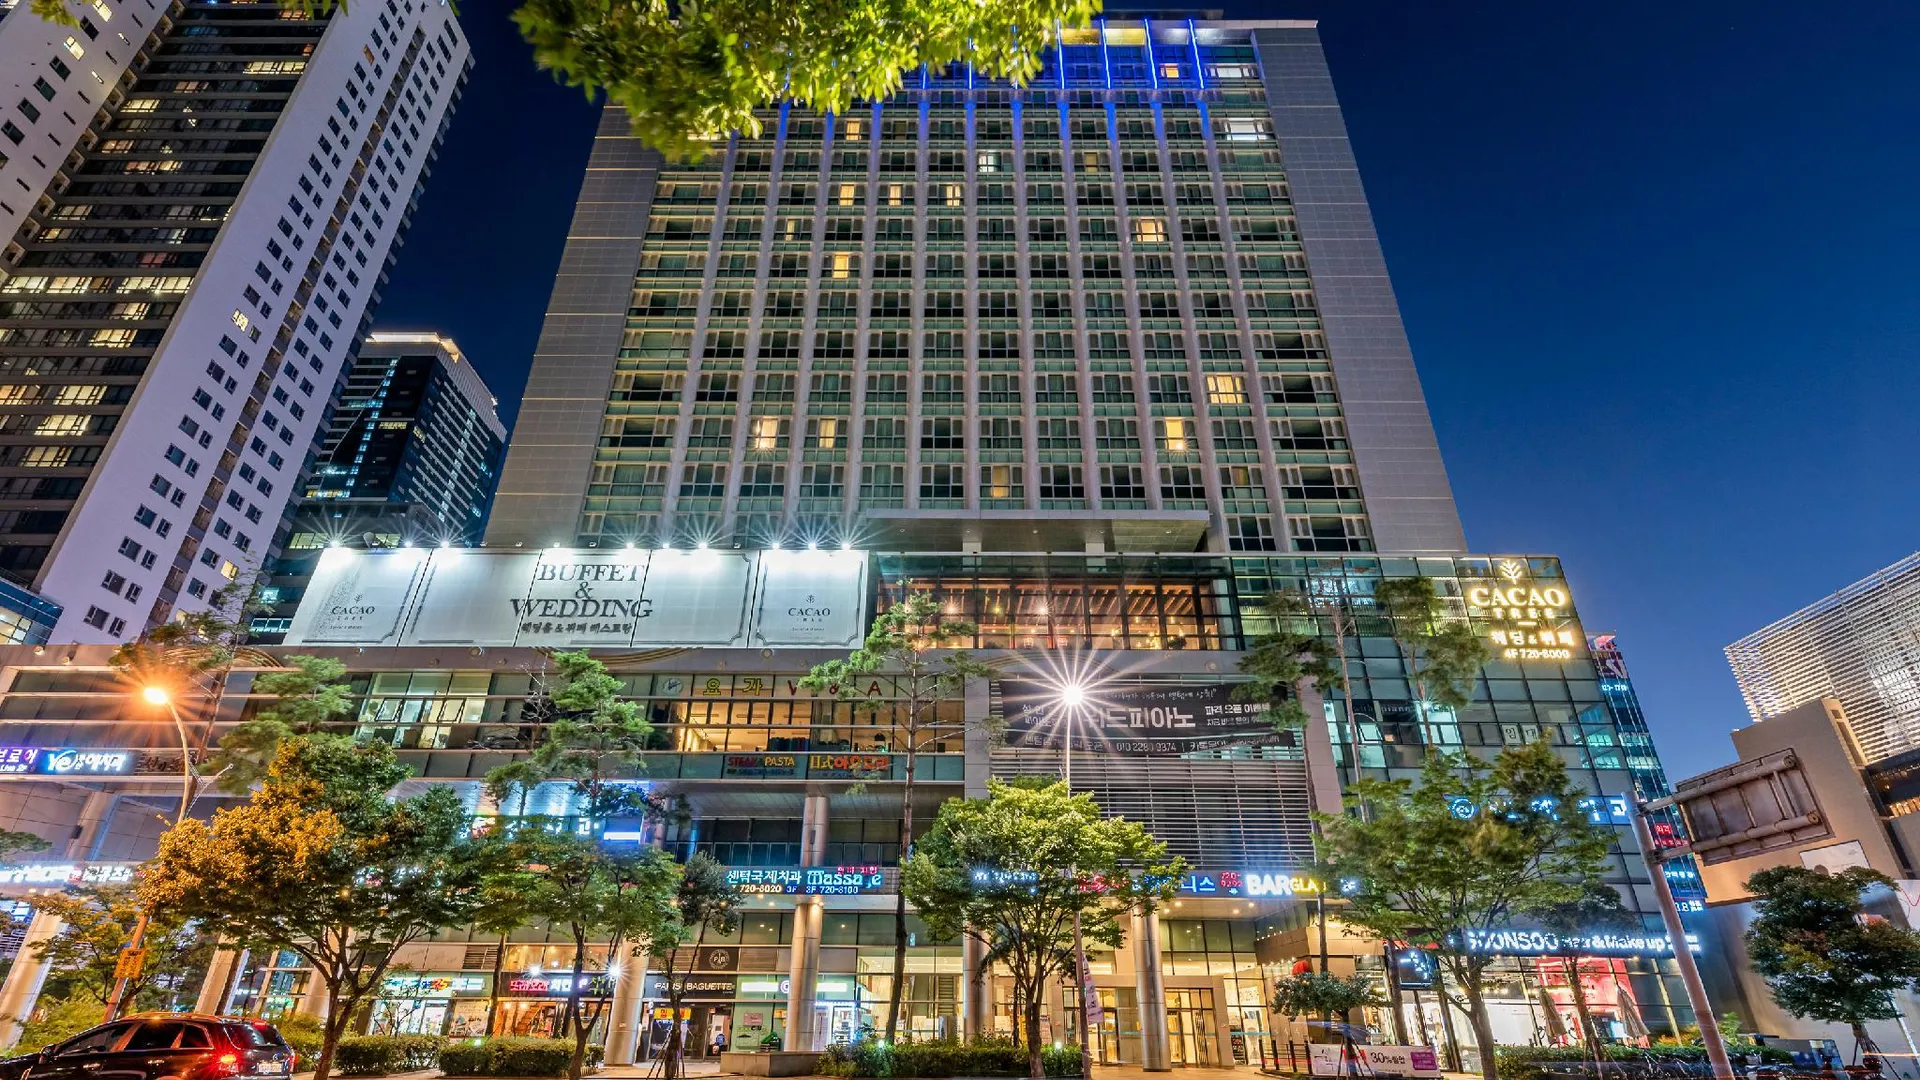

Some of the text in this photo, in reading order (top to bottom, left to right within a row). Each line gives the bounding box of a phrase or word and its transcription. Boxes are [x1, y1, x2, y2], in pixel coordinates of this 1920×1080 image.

[537, 564, 645, 581] BUFFET
[575, 581, 594, 599] &
[1470, 587, 1565, 606] CACAO
[331, 606, 375, 615] CACAO
[510, 598, 653, 618] WEDDING
[788, 607, 831, 616] CACAO
[1493, 607, 1555, 619] TREE
[764, 756, 796, 767] PASTA
[740, 884, 782, 893] 720-8020
[1246, 873, 1292, 896] BAR
[686, 982, 733, 991] BAGUETTE
